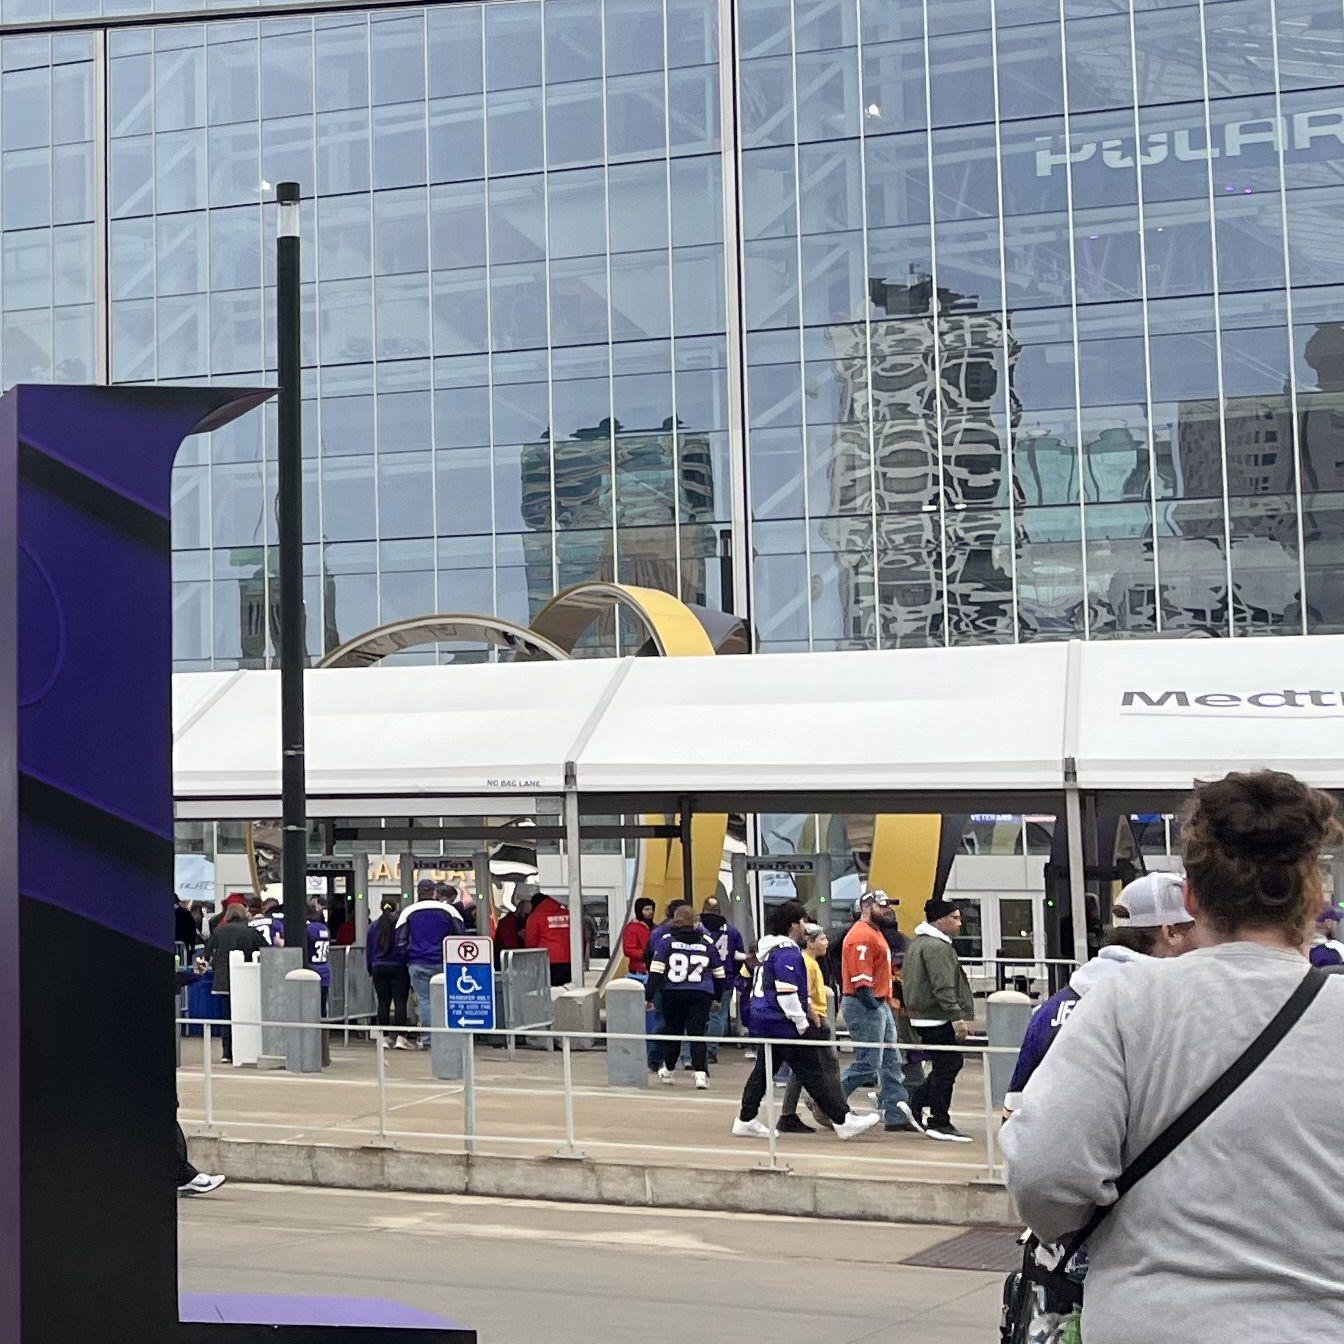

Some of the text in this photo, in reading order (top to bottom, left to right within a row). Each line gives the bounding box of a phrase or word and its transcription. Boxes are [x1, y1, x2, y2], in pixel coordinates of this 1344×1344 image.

[1121, 689, 1344, 707] Medt
[487, 779, 499, 787] NO
[856, 945, 868, 960] 7
[667, 952, 710, 983] 87
